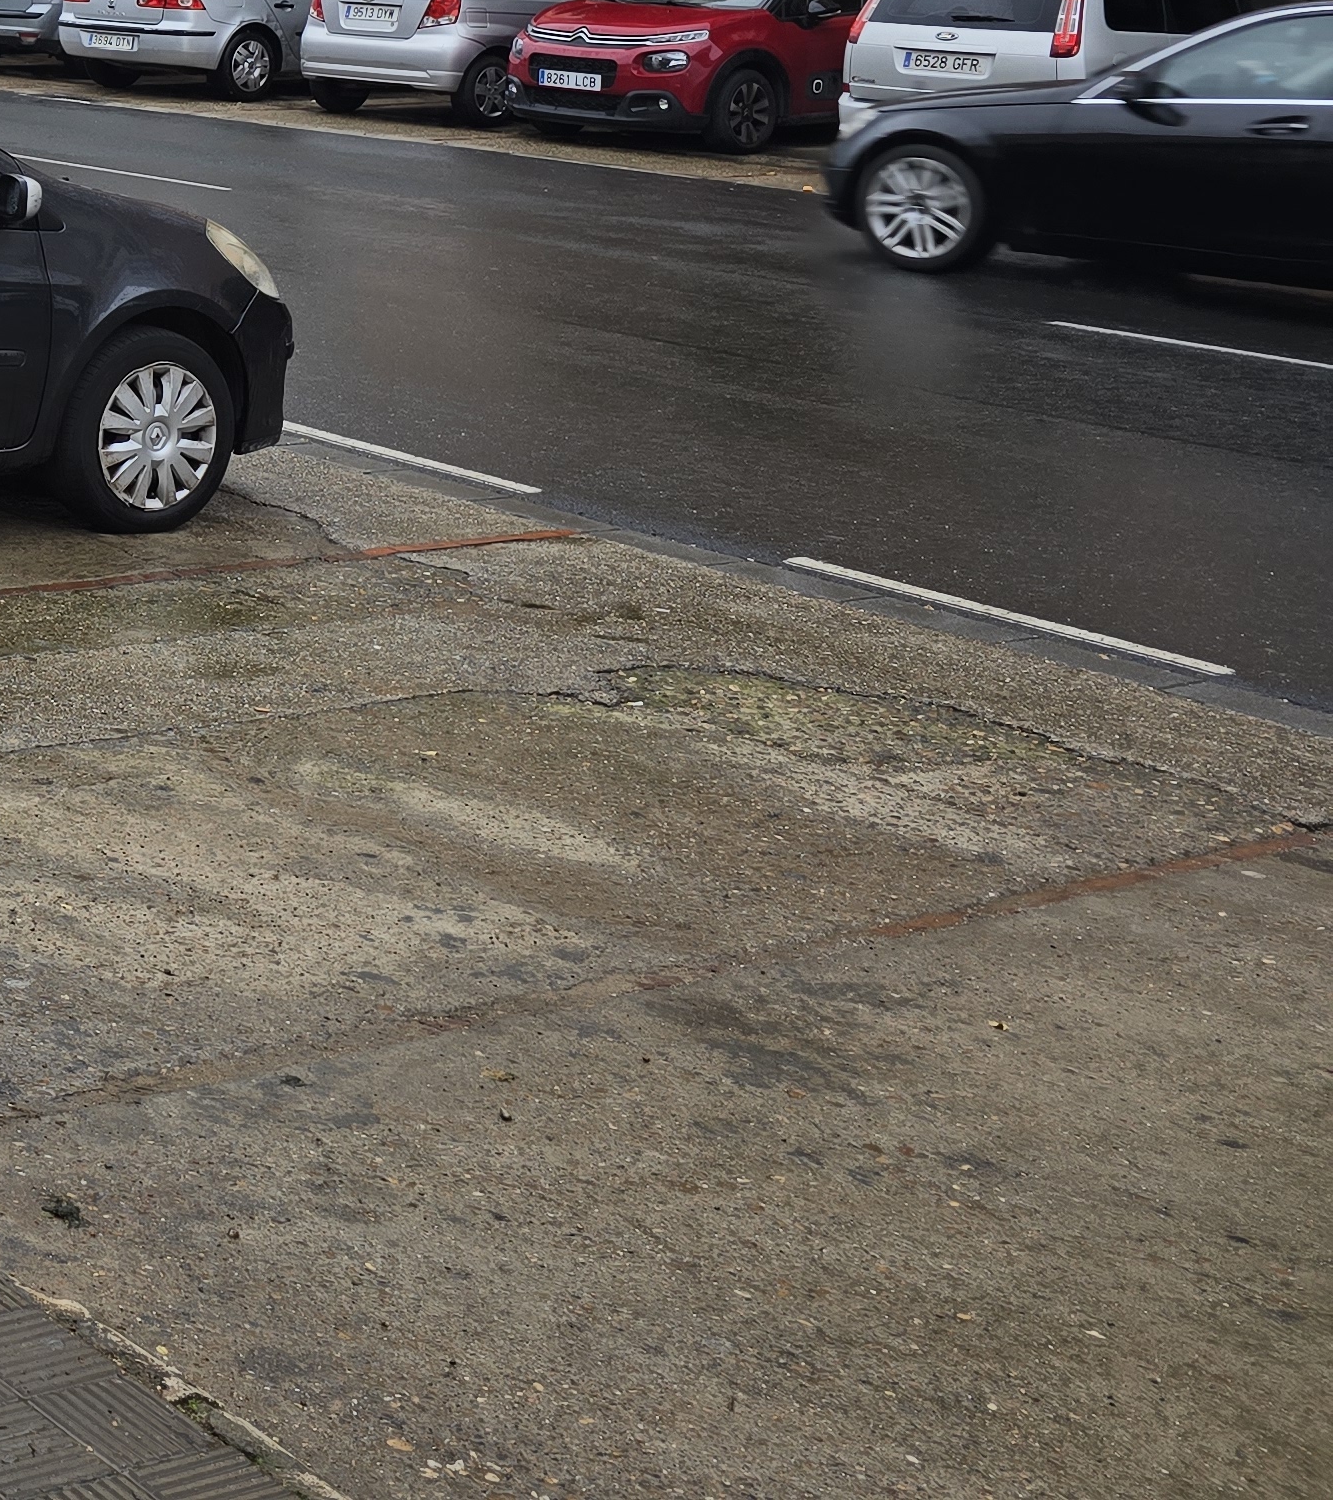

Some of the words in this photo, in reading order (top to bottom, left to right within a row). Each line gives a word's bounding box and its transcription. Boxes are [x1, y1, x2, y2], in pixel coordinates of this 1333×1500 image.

[353, 6, 375, 18] 9513
[93, 34, 113, 46] 3694
[914, 54, 948, 69] 6528
[952, 56, 980, 73] GFR
[546, 72, 570, 86] 8261
[575, 74, 596, 88] LCB
